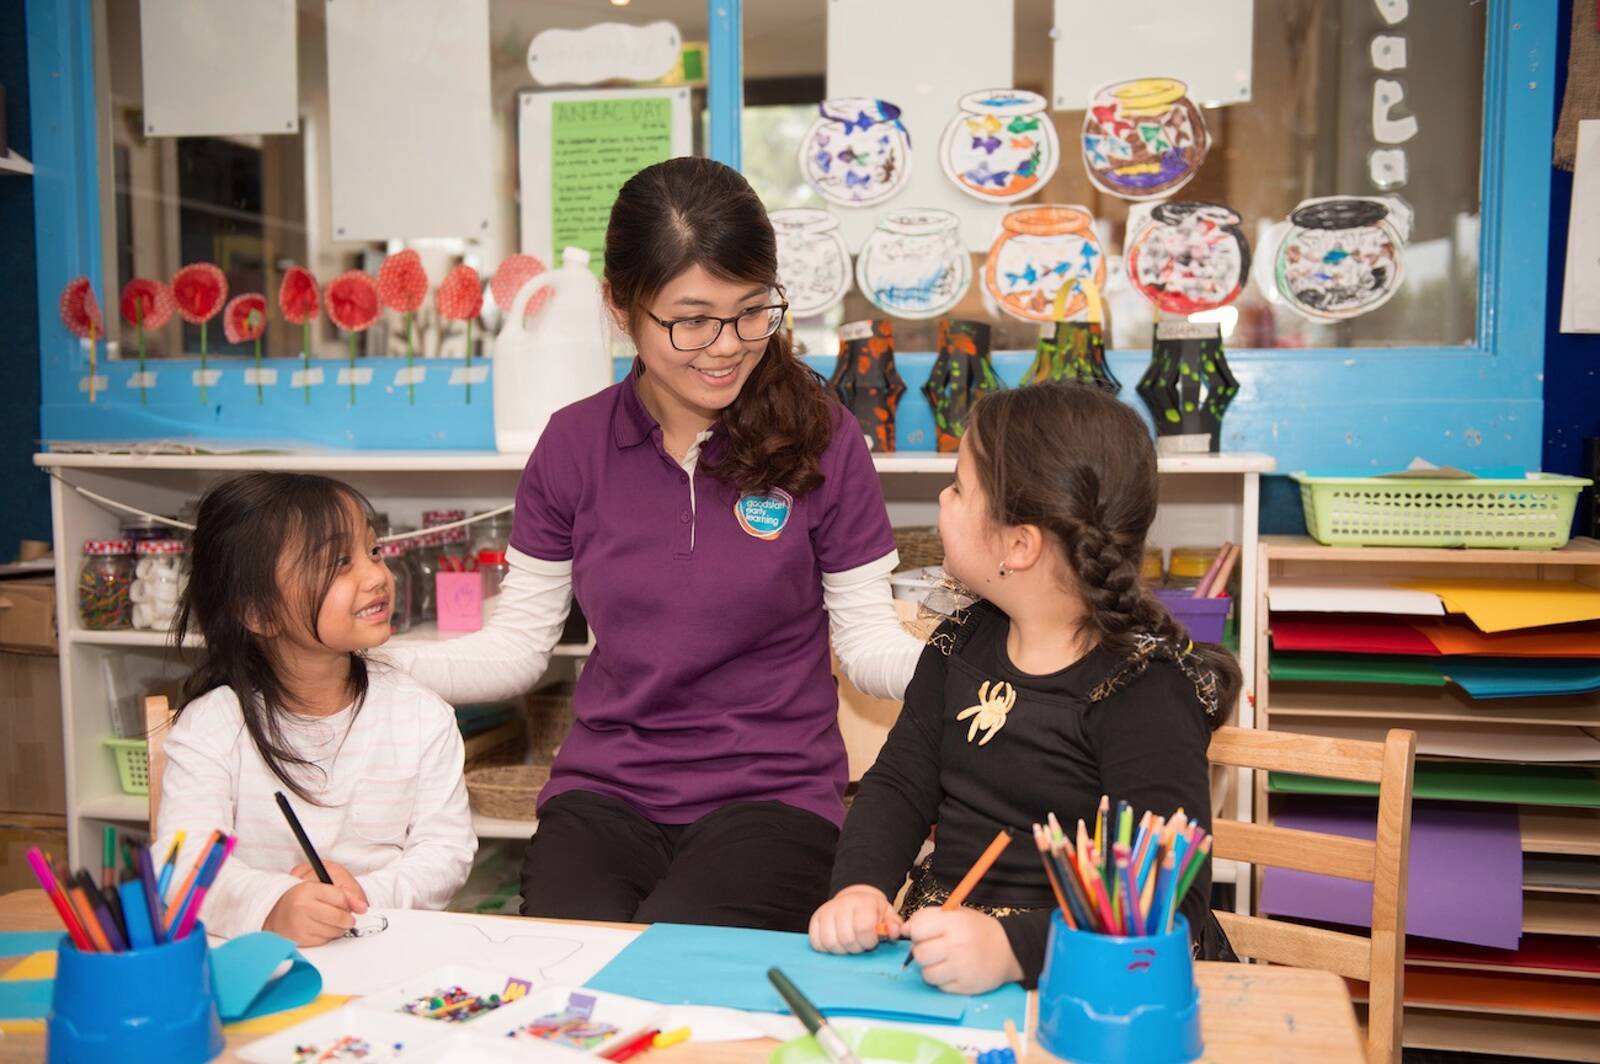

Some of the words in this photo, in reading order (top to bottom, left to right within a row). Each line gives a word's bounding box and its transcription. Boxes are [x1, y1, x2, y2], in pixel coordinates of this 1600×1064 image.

[558, 102, 623, 122] ANZAC
[631, 99, 666, 121] DAY
[745, 513, 779, 527] learning
